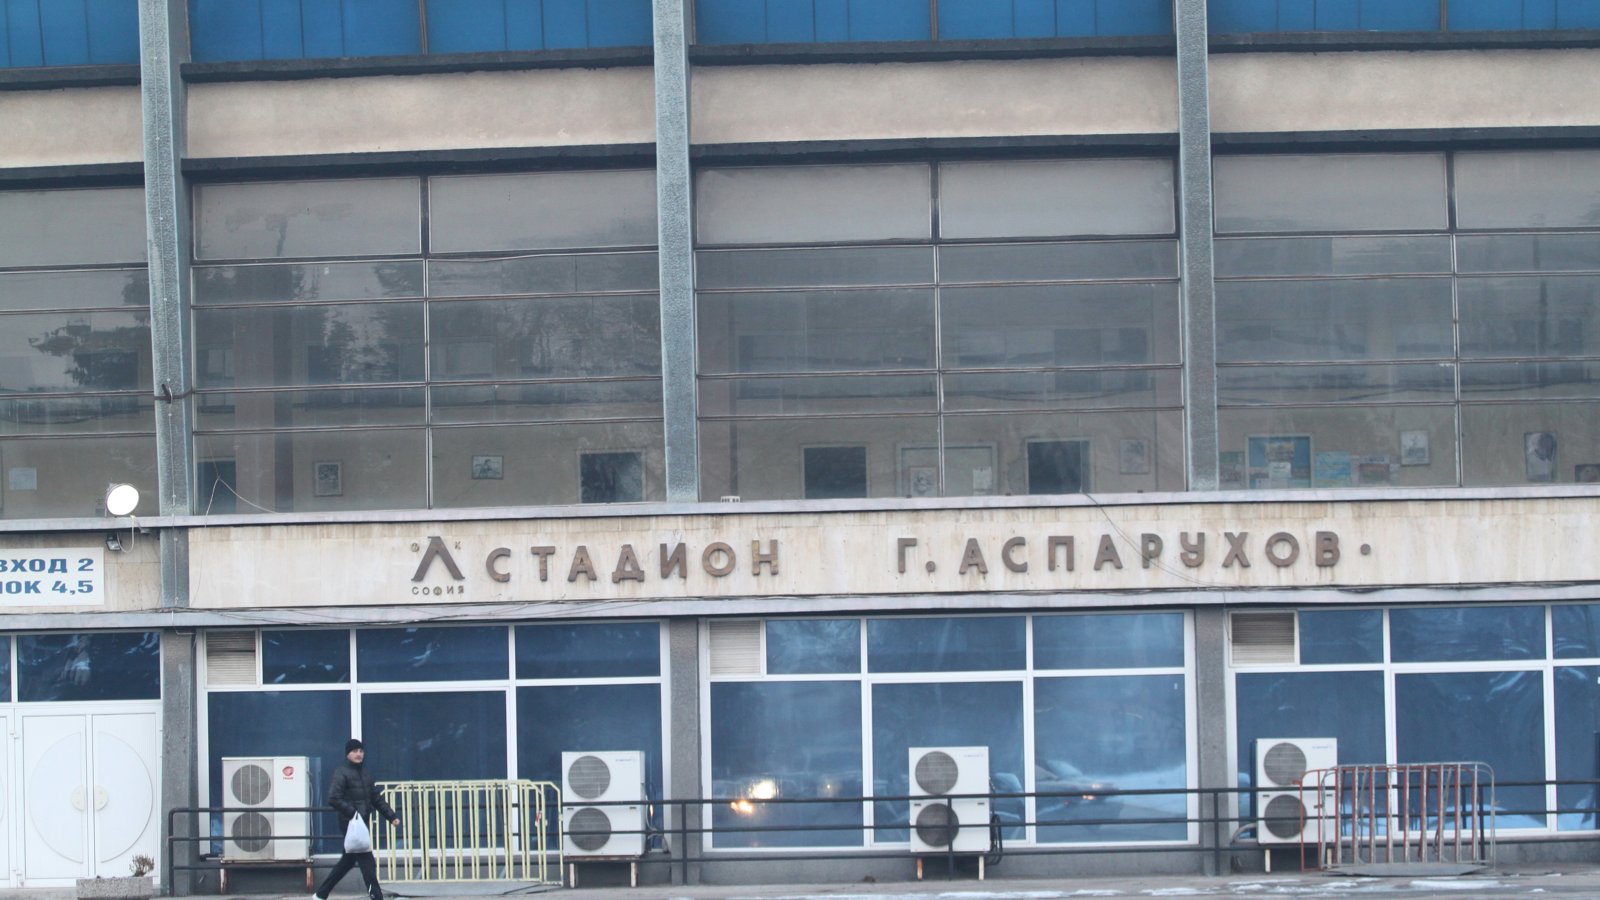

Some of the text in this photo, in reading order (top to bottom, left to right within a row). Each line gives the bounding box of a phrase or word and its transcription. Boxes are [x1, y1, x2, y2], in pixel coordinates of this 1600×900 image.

[78, 558, 94, 572] 2
[486, 539, 779, 583] СТАДИОН
[897, 537, 936, 574] Г.
[0, 580, 94, 595] ОК 4,5
[411, 585, 465, 596] СОФИЯ
